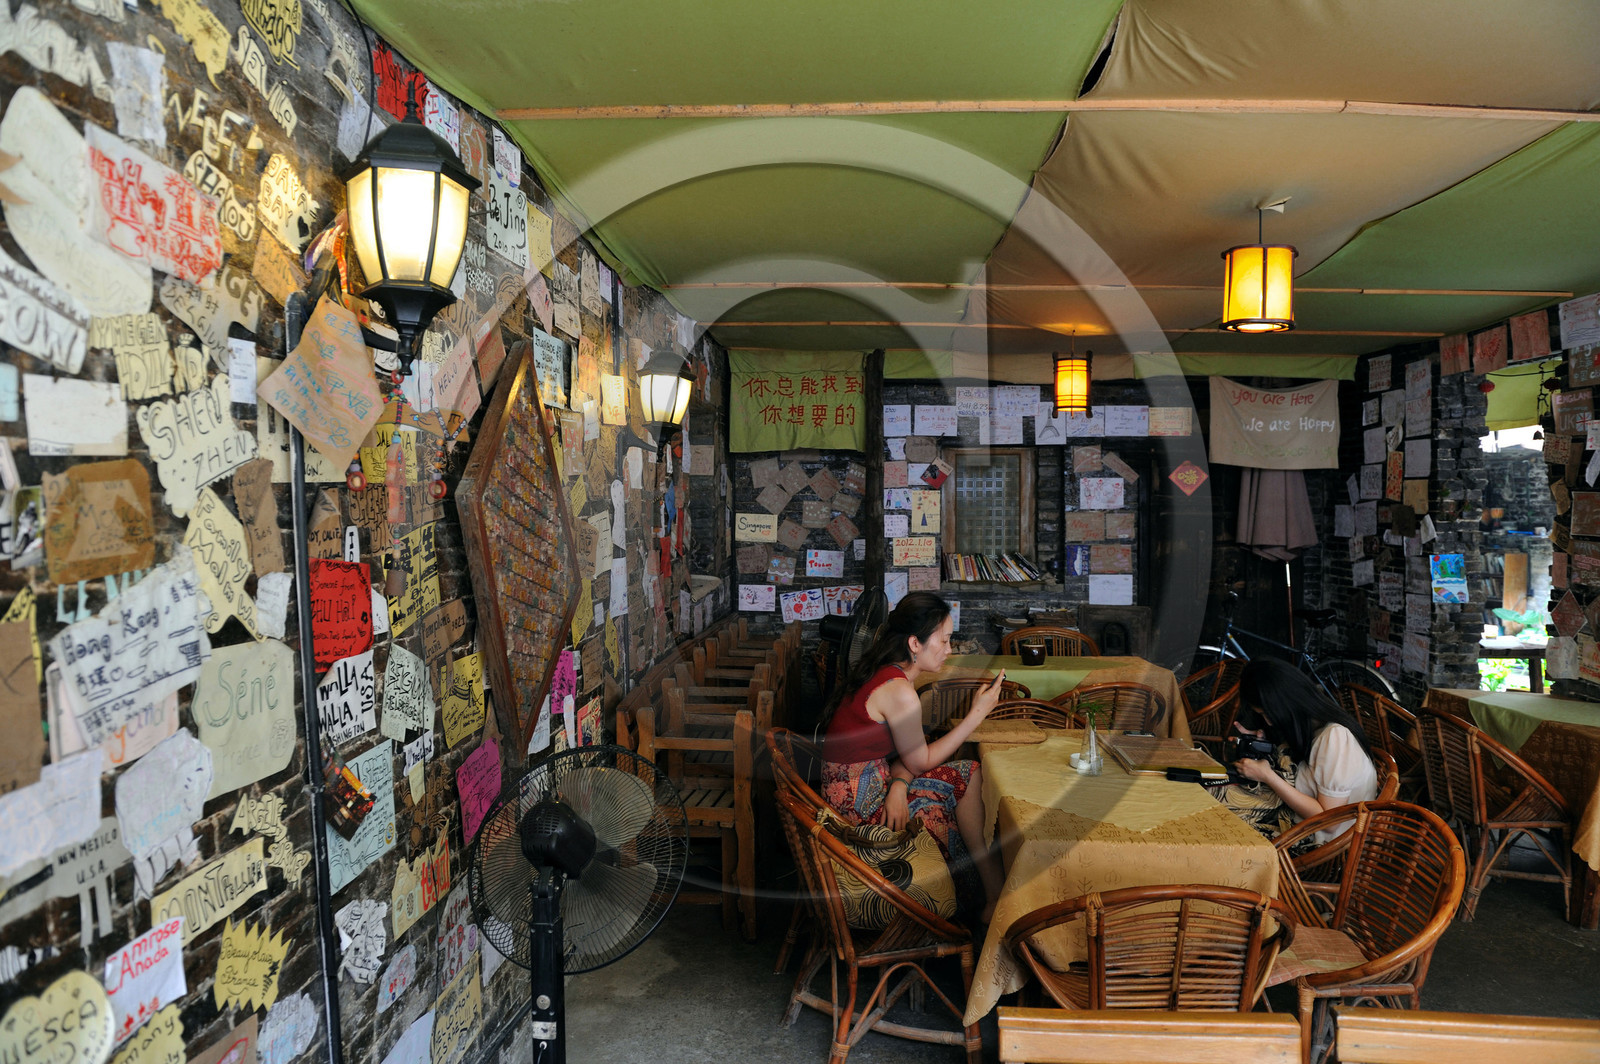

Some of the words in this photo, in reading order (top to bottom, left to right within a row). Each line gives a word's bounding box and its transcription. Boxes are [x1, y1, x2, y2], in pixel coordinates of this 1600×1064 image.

[741, 376, 865, 399] 你总能找到
[1263, 393, 1286, 405] are
[1290, 393, 1315, 406] Here
[759, 404, 855, 428] 你想要的
[1269, 419, 1292, 432] are
[738, 516, 772, 533] Singapore
[1204, 778, 1230, 786] Canon
